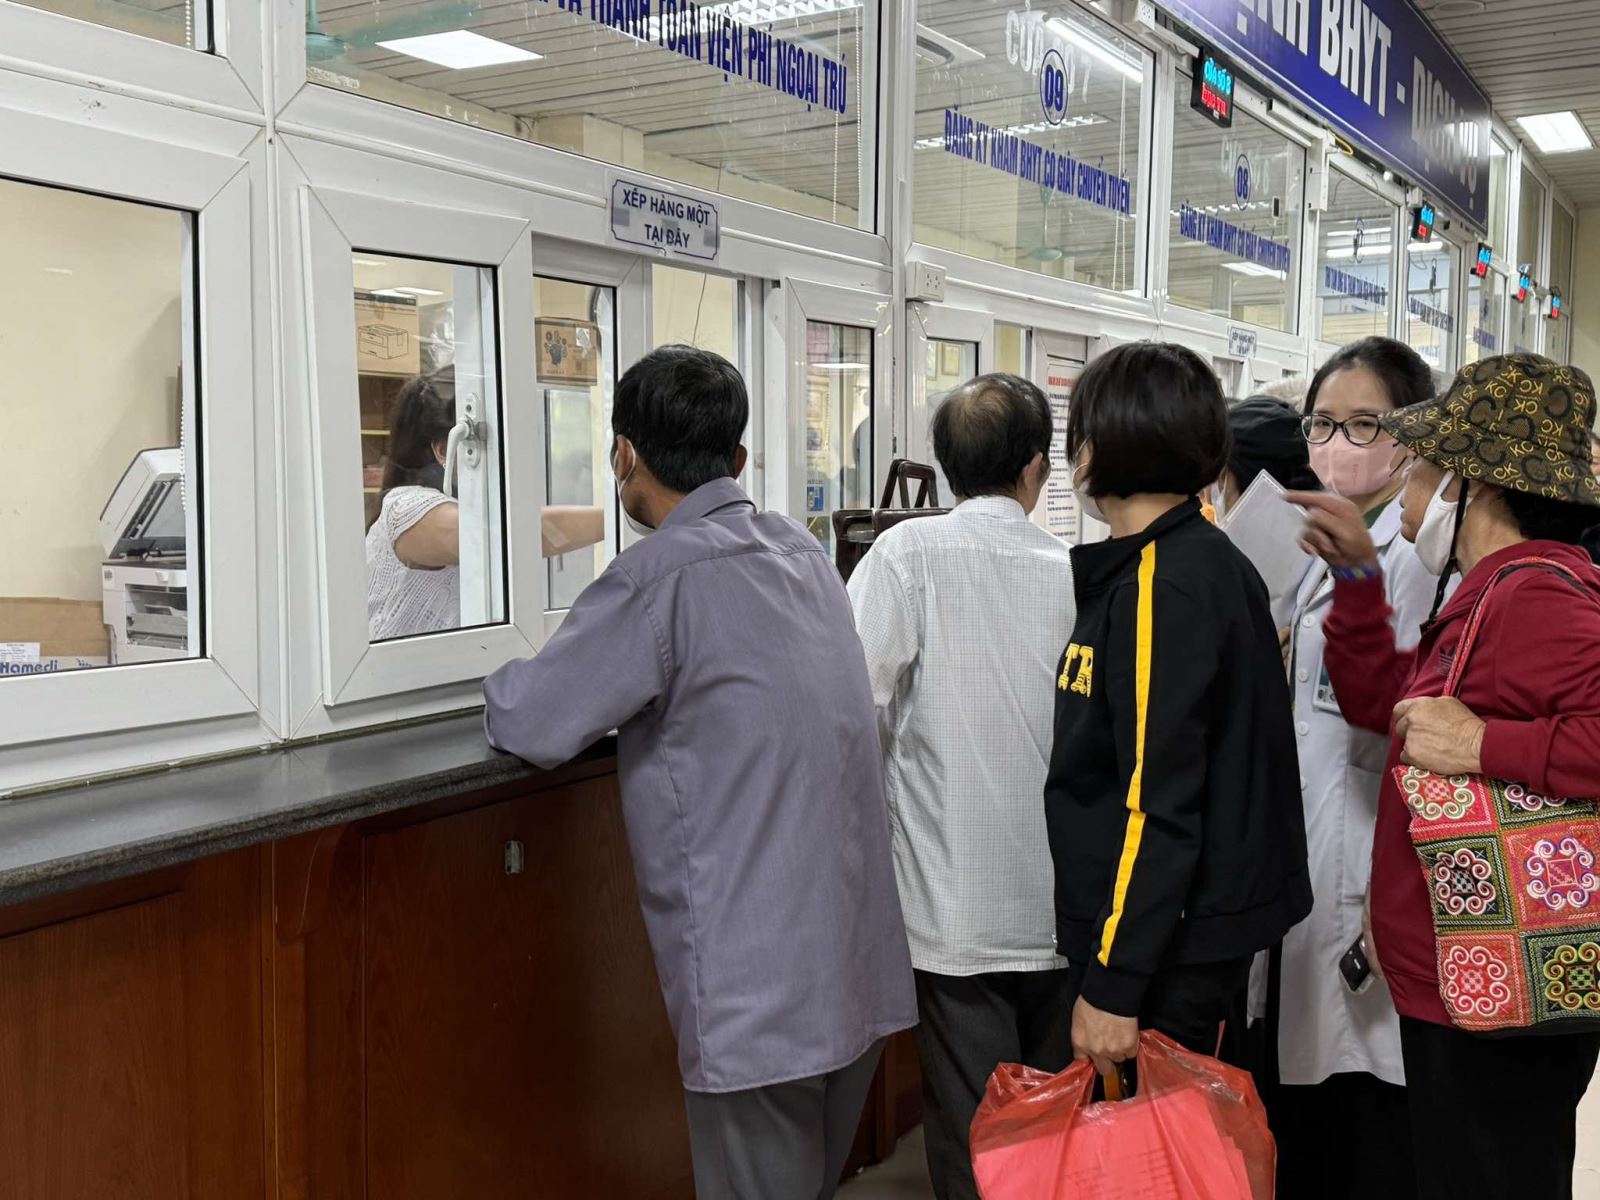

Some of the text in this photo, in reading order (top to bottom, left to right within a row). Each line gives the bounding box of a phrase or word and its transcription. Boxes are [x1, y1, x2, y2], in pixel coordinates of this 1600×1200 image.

[706, 5, 743, 82] VIỆN
[748, 24, 772, 87] PHÍ
[776, 38, 818, 112] NGOẠI
[823, 53, 847, 114] TRÚ
[1319, 0, 1393, 118] BHYT
[1044, 64, 1064, 111] 09
[1020, 139, 1042, 185] BHYT
[1044, 143, 1056, 189] CÓ
[1236, 165, 1249, 200] 08
[622, 187, 710, 229] XẾP HÀNG MỘT
[644, 223, 690, 248] TẠI ĐÂY
